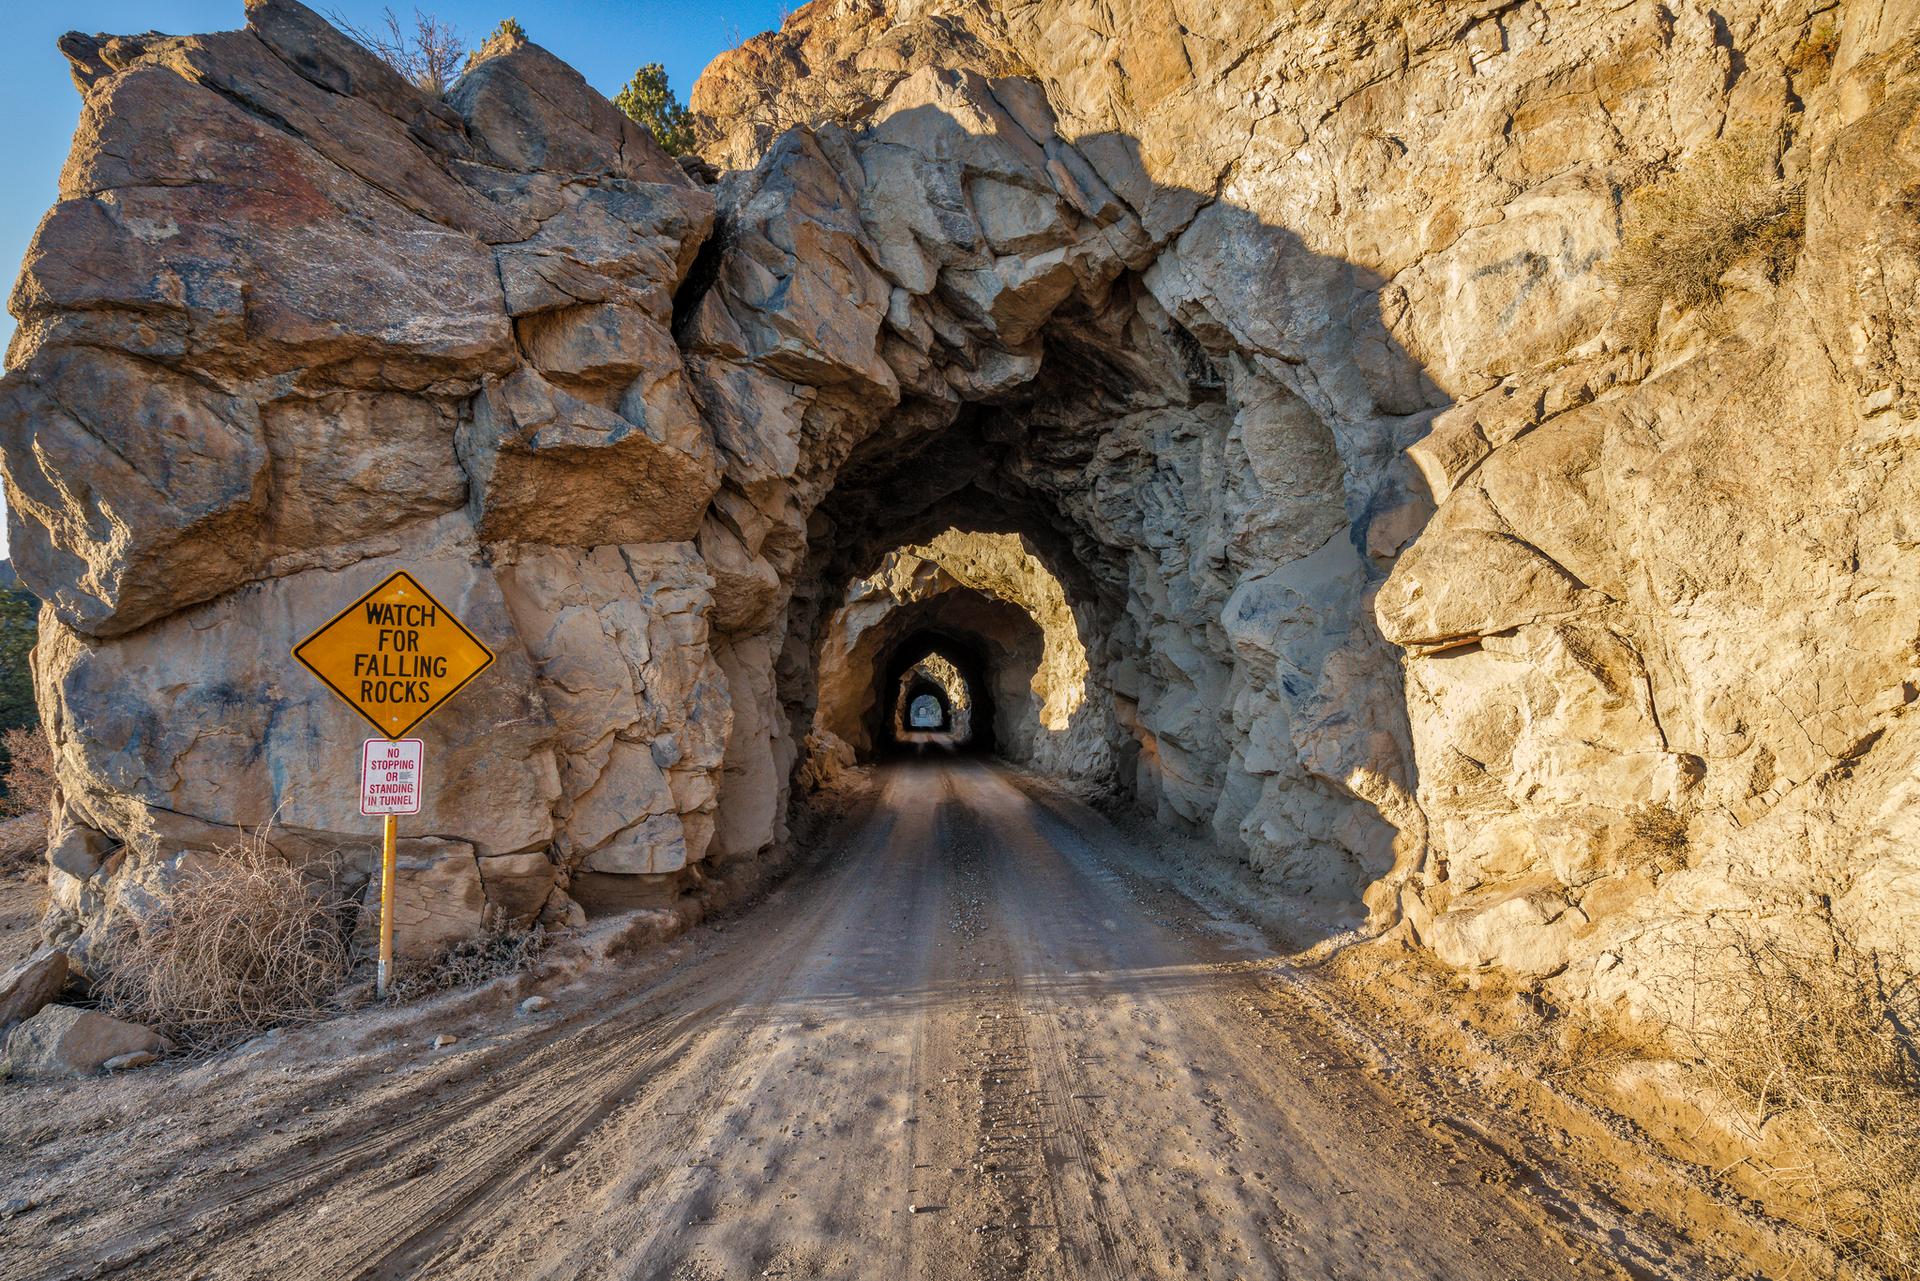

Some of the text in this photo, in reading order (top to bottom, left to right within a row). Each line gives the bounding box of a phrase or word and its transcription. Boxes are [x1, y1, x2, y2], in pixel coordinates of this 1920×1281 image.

[366, 602, 435, 627] WATCH
[378, 629, 419, 652] FOR
[353, 654, 447, 678] FALLING
[360, 680, 430, 703] ROCKS
[387, 748, 400, 758] NO
[371, 760, 414, 770] STOPPING
[386, 772, 398, 782] OR
[369, 784, 413, 794] STANDING
[368, 795, 413, 806] IN TUNNEL
